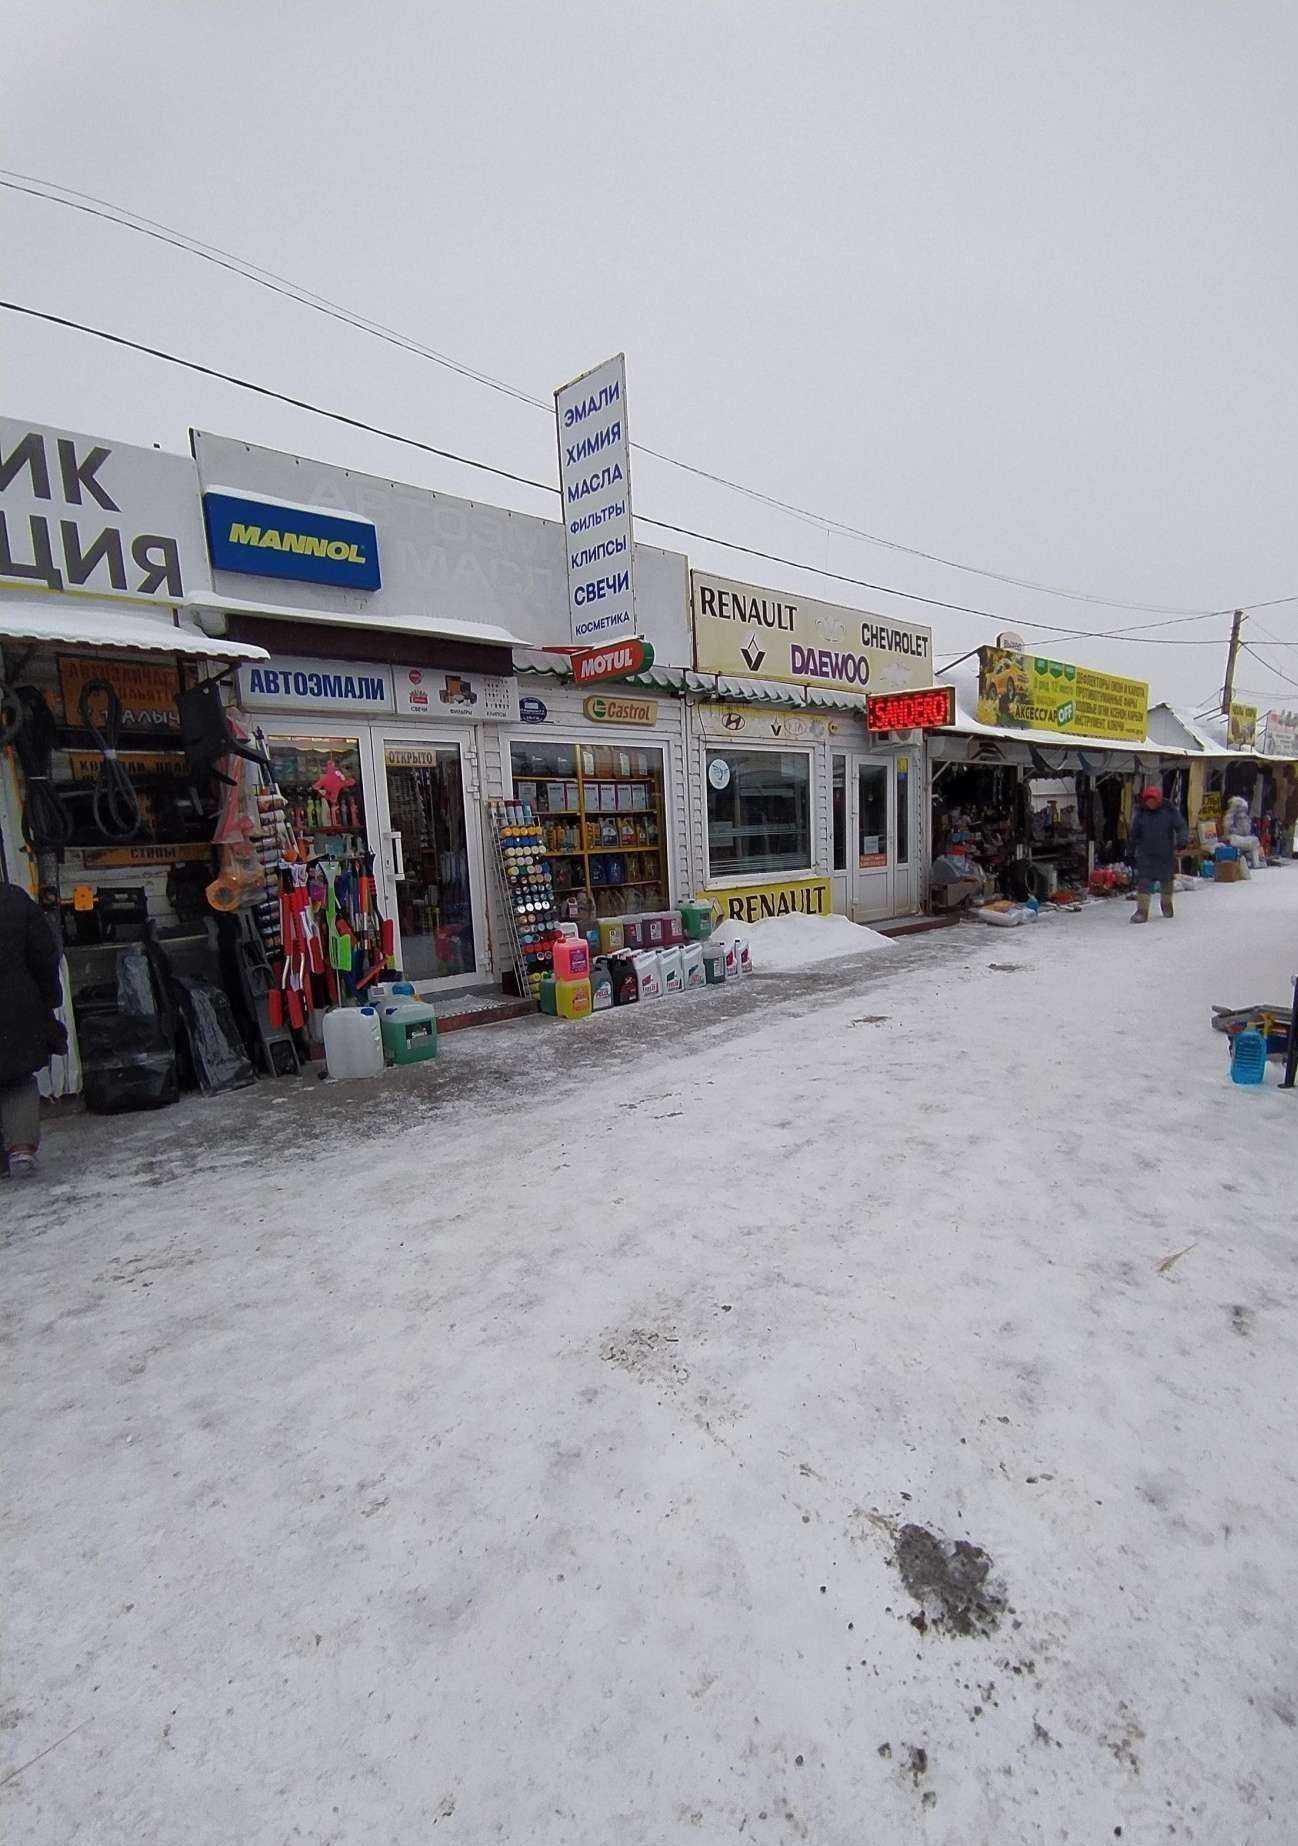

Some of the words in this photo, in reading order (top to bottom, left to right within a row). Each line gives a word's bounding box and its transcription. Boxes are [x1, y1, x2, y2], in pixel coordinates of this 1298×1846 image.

[563, 380, 621, 428] ЭМАЛИ
[566, 420, 622, 467] ХИМИЯ
[567, 463, 624, 503] МАСЛА
[569, 500, 626, 534] ФИЛЬТРЫ
[228, 522, 367, 565] MANNOL
[570, 535, 628, 569] КЛИПСЫ
[573, 570, 630, 607] СВЕЧИ
[575, 610, 631, 637] КОСМЕТИКА
[699, 586, 798, 632] RENAULT
[861, 622, 929, 658] CHEVROLET
[580, 648, 634, 680] MOTUL
[790, 643, 870, 686] DAEWOO
[249, 668, 386, 701] АВТОЭМАЛИ
[607, 701, 651, 721] Castrol
[388, 750, 433, 765] ОТКРЫТО
[728, 886, 826, 924] RENAULT
